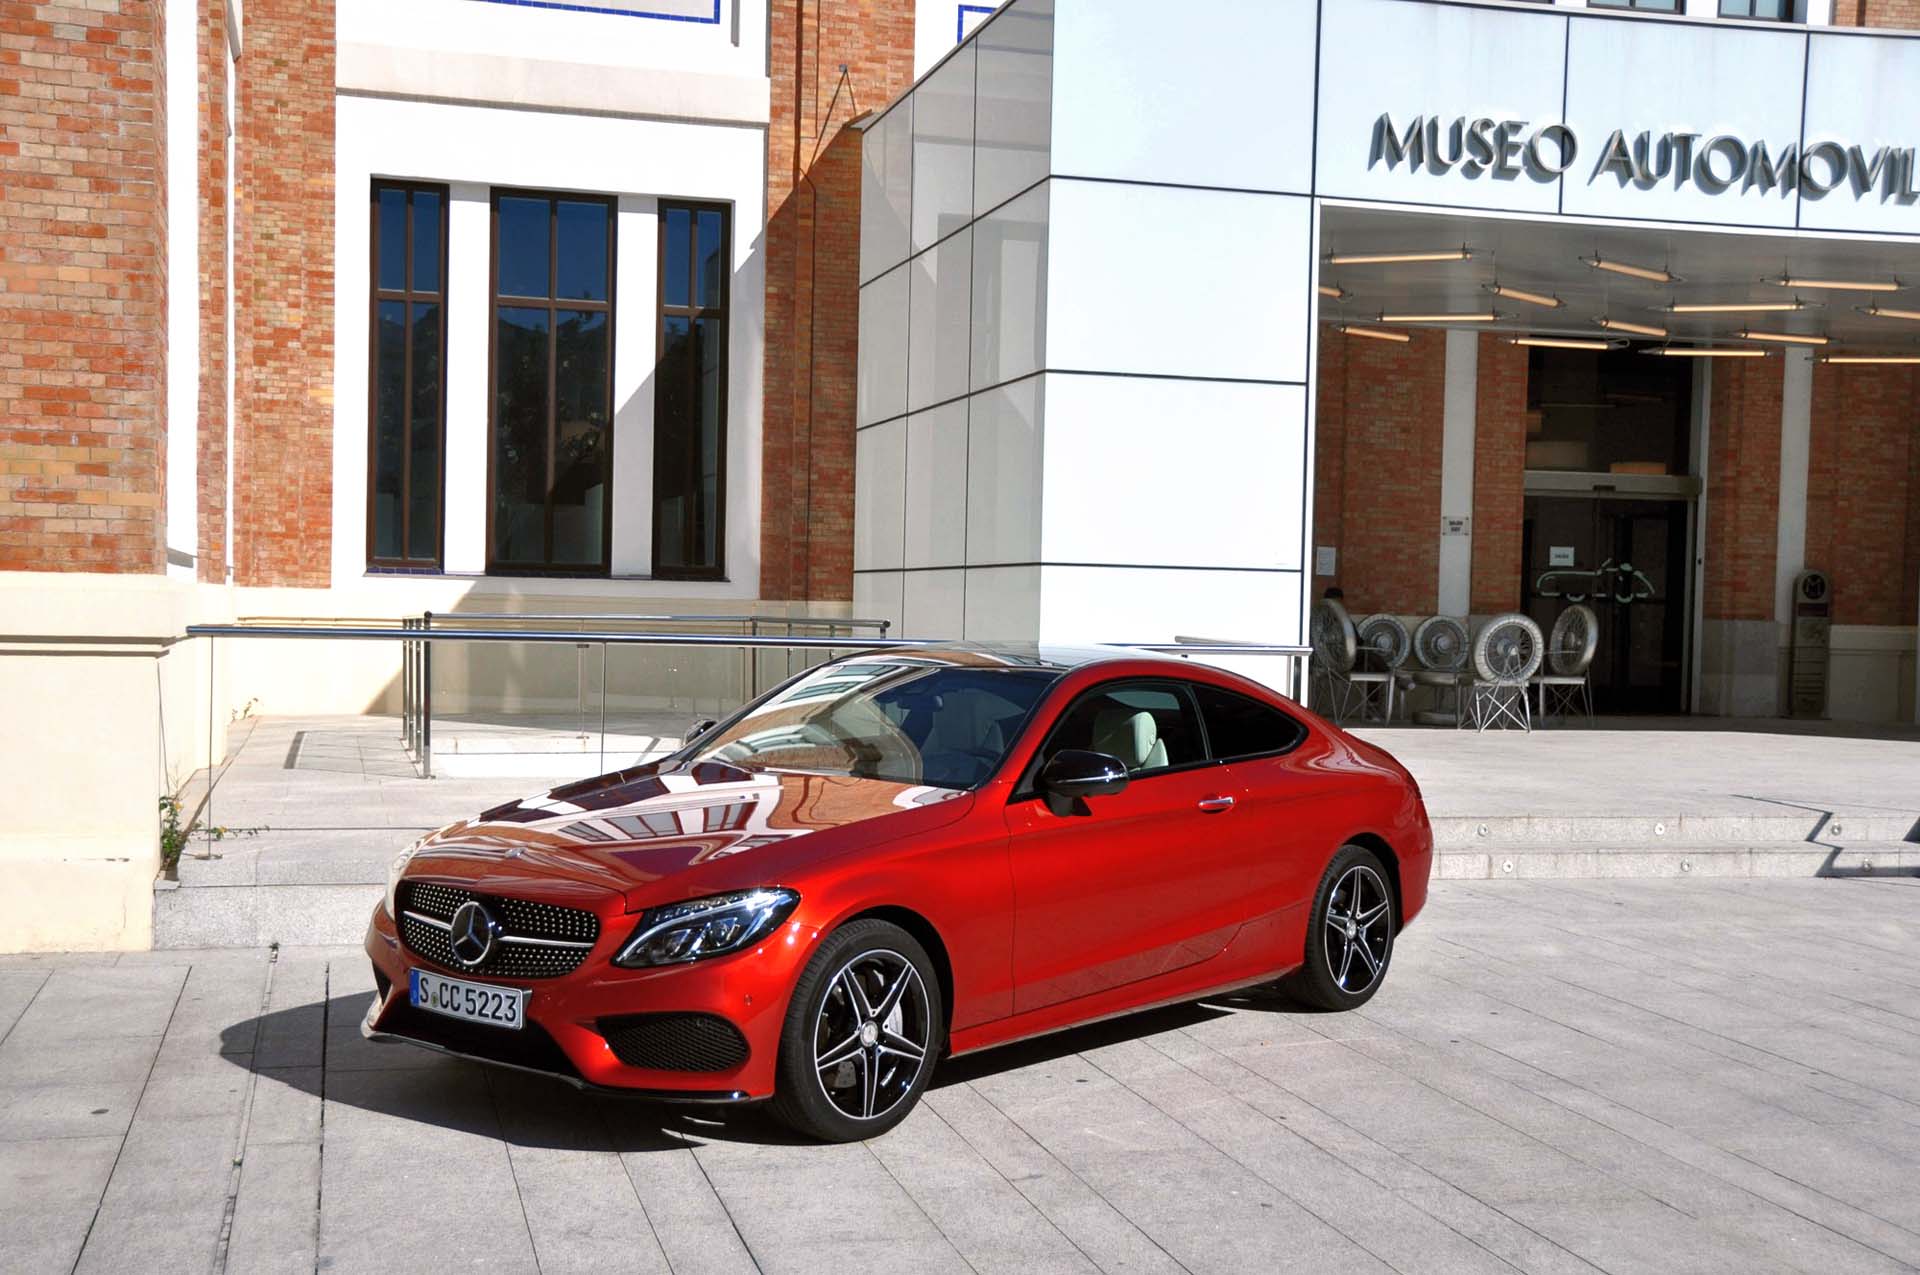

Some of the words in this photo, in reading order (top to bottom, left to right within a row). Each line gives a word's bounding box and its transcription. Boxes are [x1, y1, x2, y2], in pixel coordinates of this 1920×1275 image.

[1367, 111, 1578, 183] MUSEO
[420, 977, 429, 1003] S
[439, 983, 461, 1012] CC
[465, 989, 517, 1022] 5223
